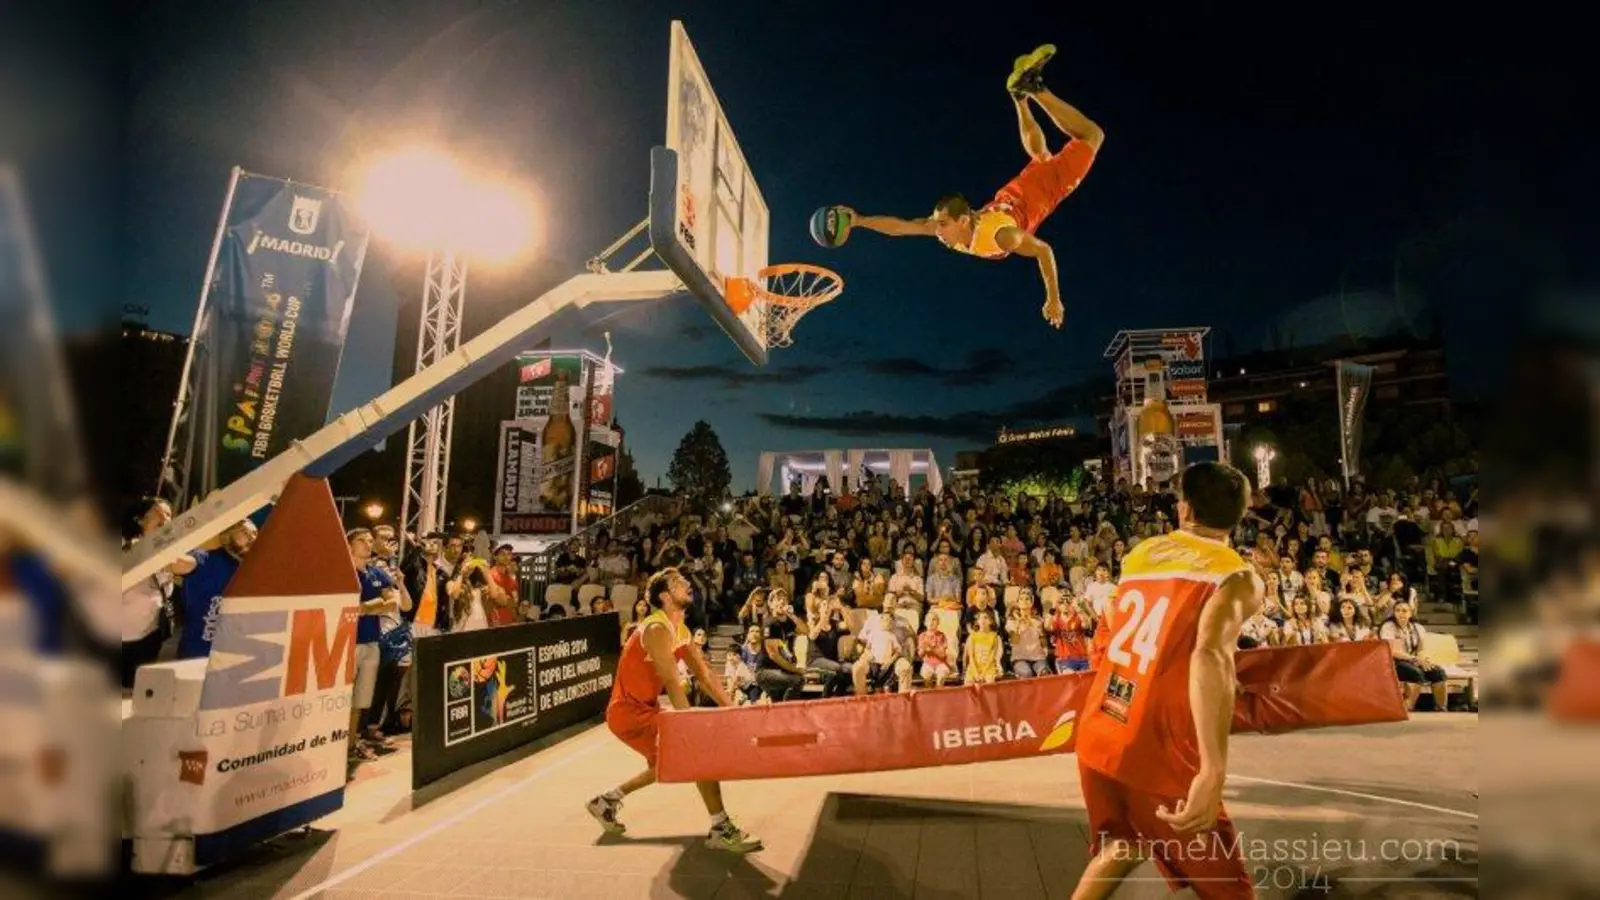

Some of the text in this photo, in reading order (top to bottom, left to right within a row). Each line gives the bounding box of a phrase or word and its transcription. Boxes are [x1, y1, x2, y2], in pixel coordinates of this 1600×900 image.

[252, 296, 302, 458] FIBA BASKETBALL WORLD CUP
[504, 430, 520, 508] LLAMADO
[503, 516, 566, 530] MUNDO
[1107, 589, 1170, 675] 24
[538, 640, 570, 663] ESPAÑA
[540, 667, 561, 687] COPA
[562, 663, 577, 680] DEL
[450, 704, 468, 721] FIBA
[540, 693, 552, 711] DE
[932, 718, 1038, 750] IBERIA
[217, 740, 306, 773] Comunidad
[309, 735, 327, 749] de
